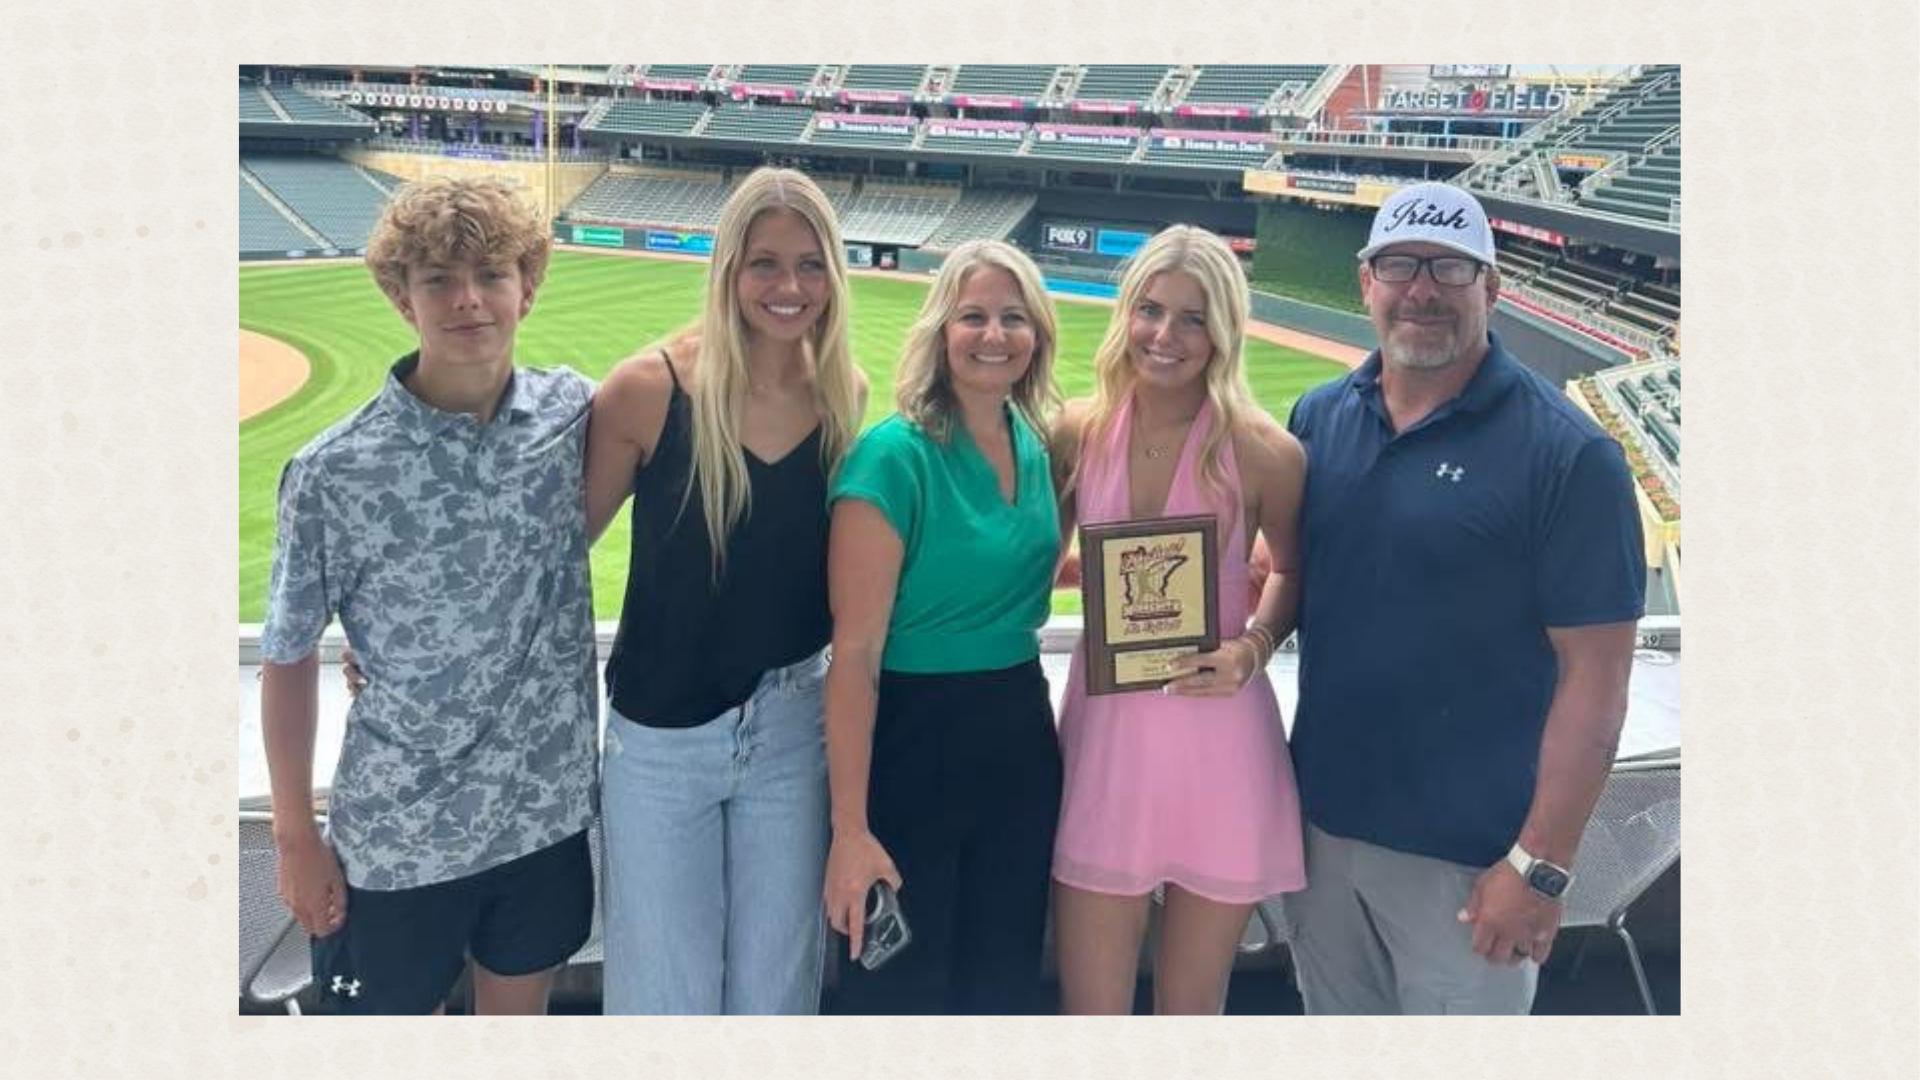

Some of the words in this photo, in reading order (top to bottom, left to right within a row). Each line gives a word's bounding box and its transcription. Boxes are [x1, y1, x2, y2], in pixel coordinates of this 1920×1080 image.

[1384, 90, 1468, 110] TARGET
[1490, 89, 1564, 110] FIELD
[1384, 198, 1469, 232] Irish
